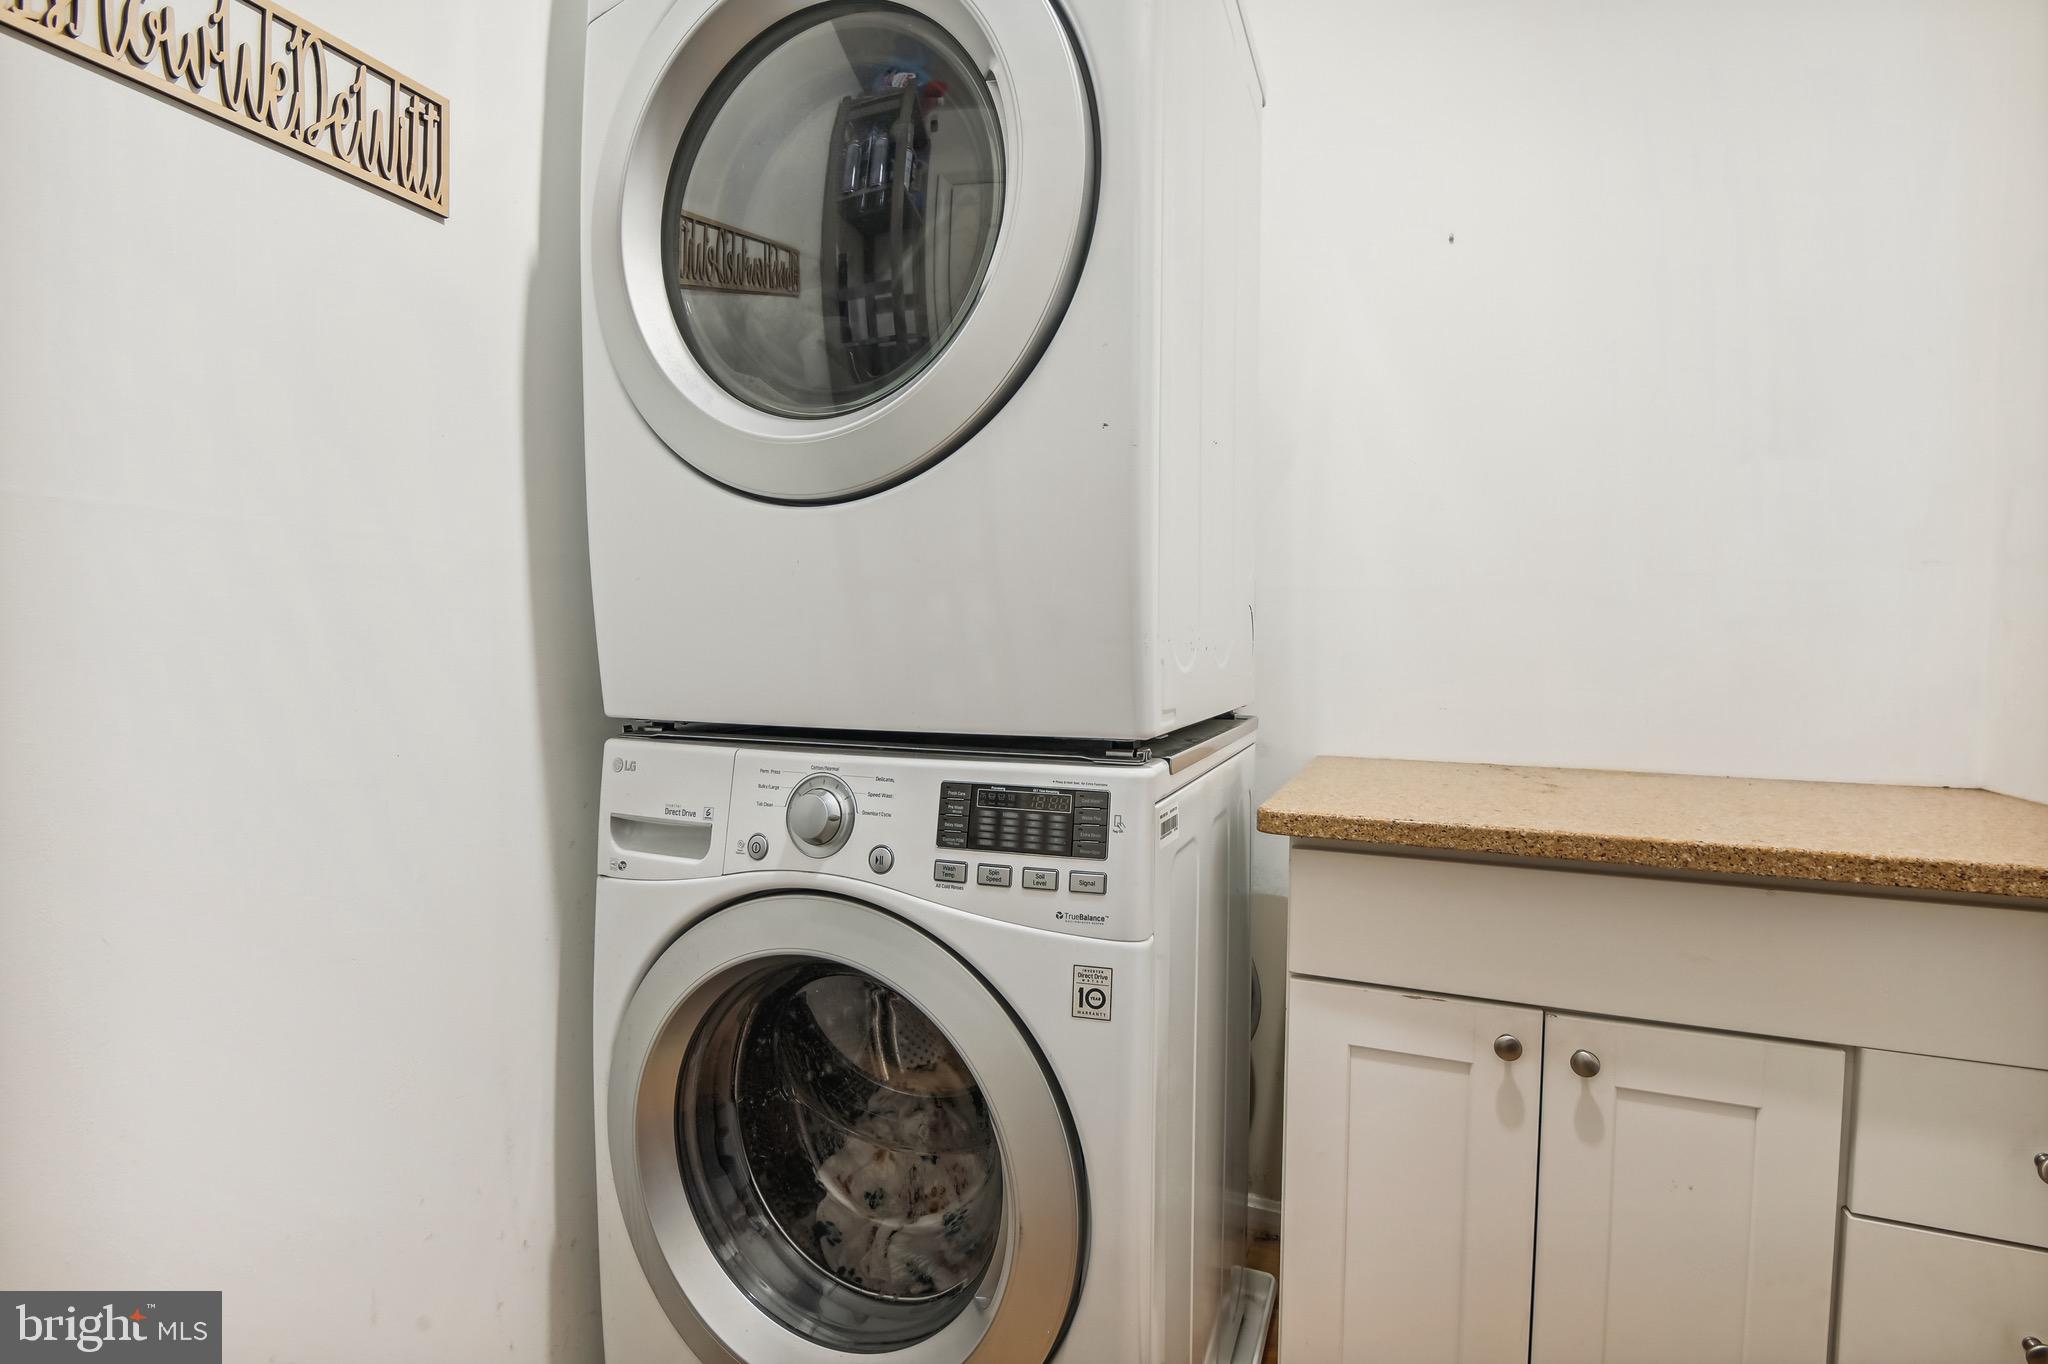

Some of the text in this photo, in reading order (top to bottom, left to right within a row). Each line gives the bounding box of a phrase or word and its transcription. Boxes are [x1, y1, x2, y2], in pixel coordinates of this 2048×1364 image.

[664, 807, 681, 816] Direct
[681, 809, 697, 818] Drive
[942, 871, 955, 879] Temp
[1078, 987, 1106, 1010] 10
